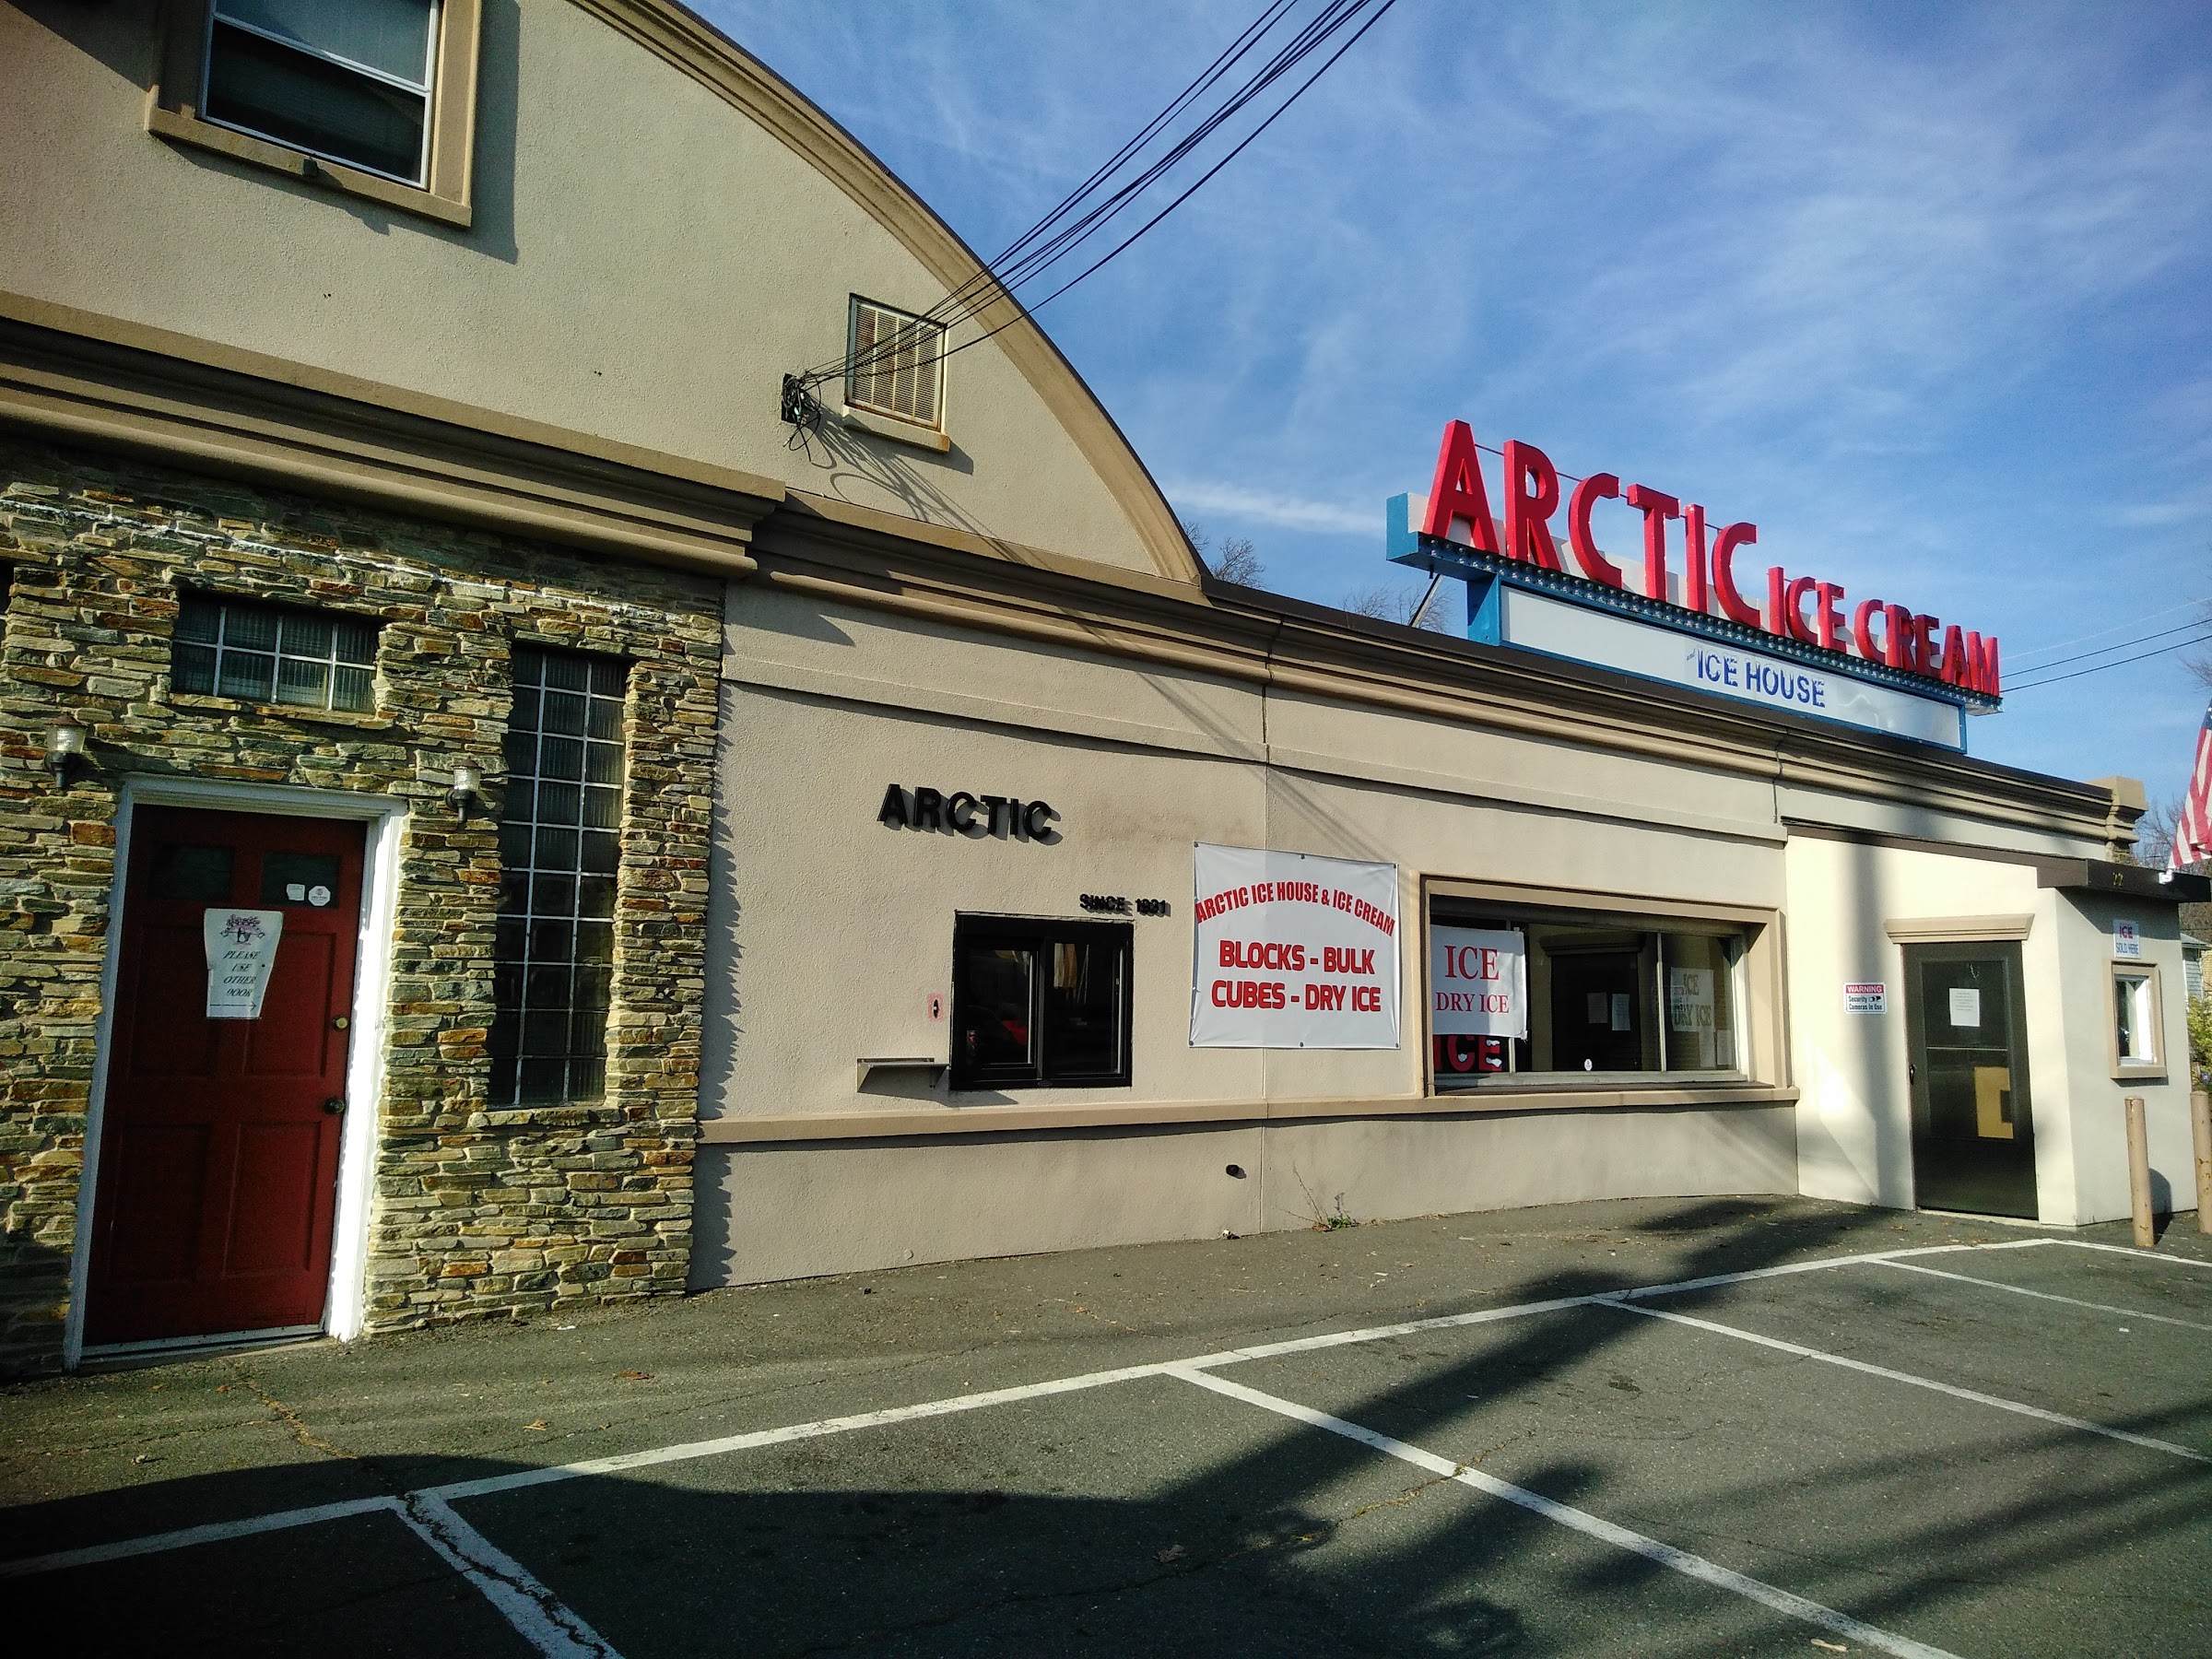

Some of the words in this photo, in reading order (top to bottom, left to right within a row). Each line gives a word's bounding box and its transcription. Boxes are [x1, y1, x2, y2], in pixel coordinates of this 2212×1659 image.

[1422, 418, 1760, 629] ARCTIC
[1767, 565, 1846, 653] ICE
[1853, 598, 1999, 697] CREAM
[1697, 648, 1738, 688] ICE
[1746, 658, 1826, 709] HOUSE
[877, 783, 1053, 840] ARCTIC
[1079, 893, 1126, 912] SINCE
[1194, 887, 1249, 924] ARCTIC
[1251, 882, 1274, 905] ICE
[1277, 881, 1319, 903] HOUSE
[1321, 888, 1331, 906] &
[1332, 889, 1353, 913] ICE
[1354, 898, 1396, 937] CREAM
[2119, 925, 2134, 939] ICE
[223, 950, 261, 959] PLEASE
[1219, 939, 1305, 971] BLOCKS
[1310, 957, 1319, 965] -
[1324, 947, 1375, 975] BULK
[2115, 942, 2128, 953] SOLD
[1443, 945, 1500, 981] ICE
[223, 976, 256, 984] OTHER
[1847, 985, 1883, 994] WARNING
[226, 988, 253, 997] DOOR
[1211, 980, 1286, 1009] CUBES
[1305, 983, 1347, 1011] DRY
[1351, 985, 1382, 1012] ICE
[1848, 995, 1868, 1004] Security
[1436, 992, 1476, 1012] DRY
[1479, 993, 1510, 1014] ICE
